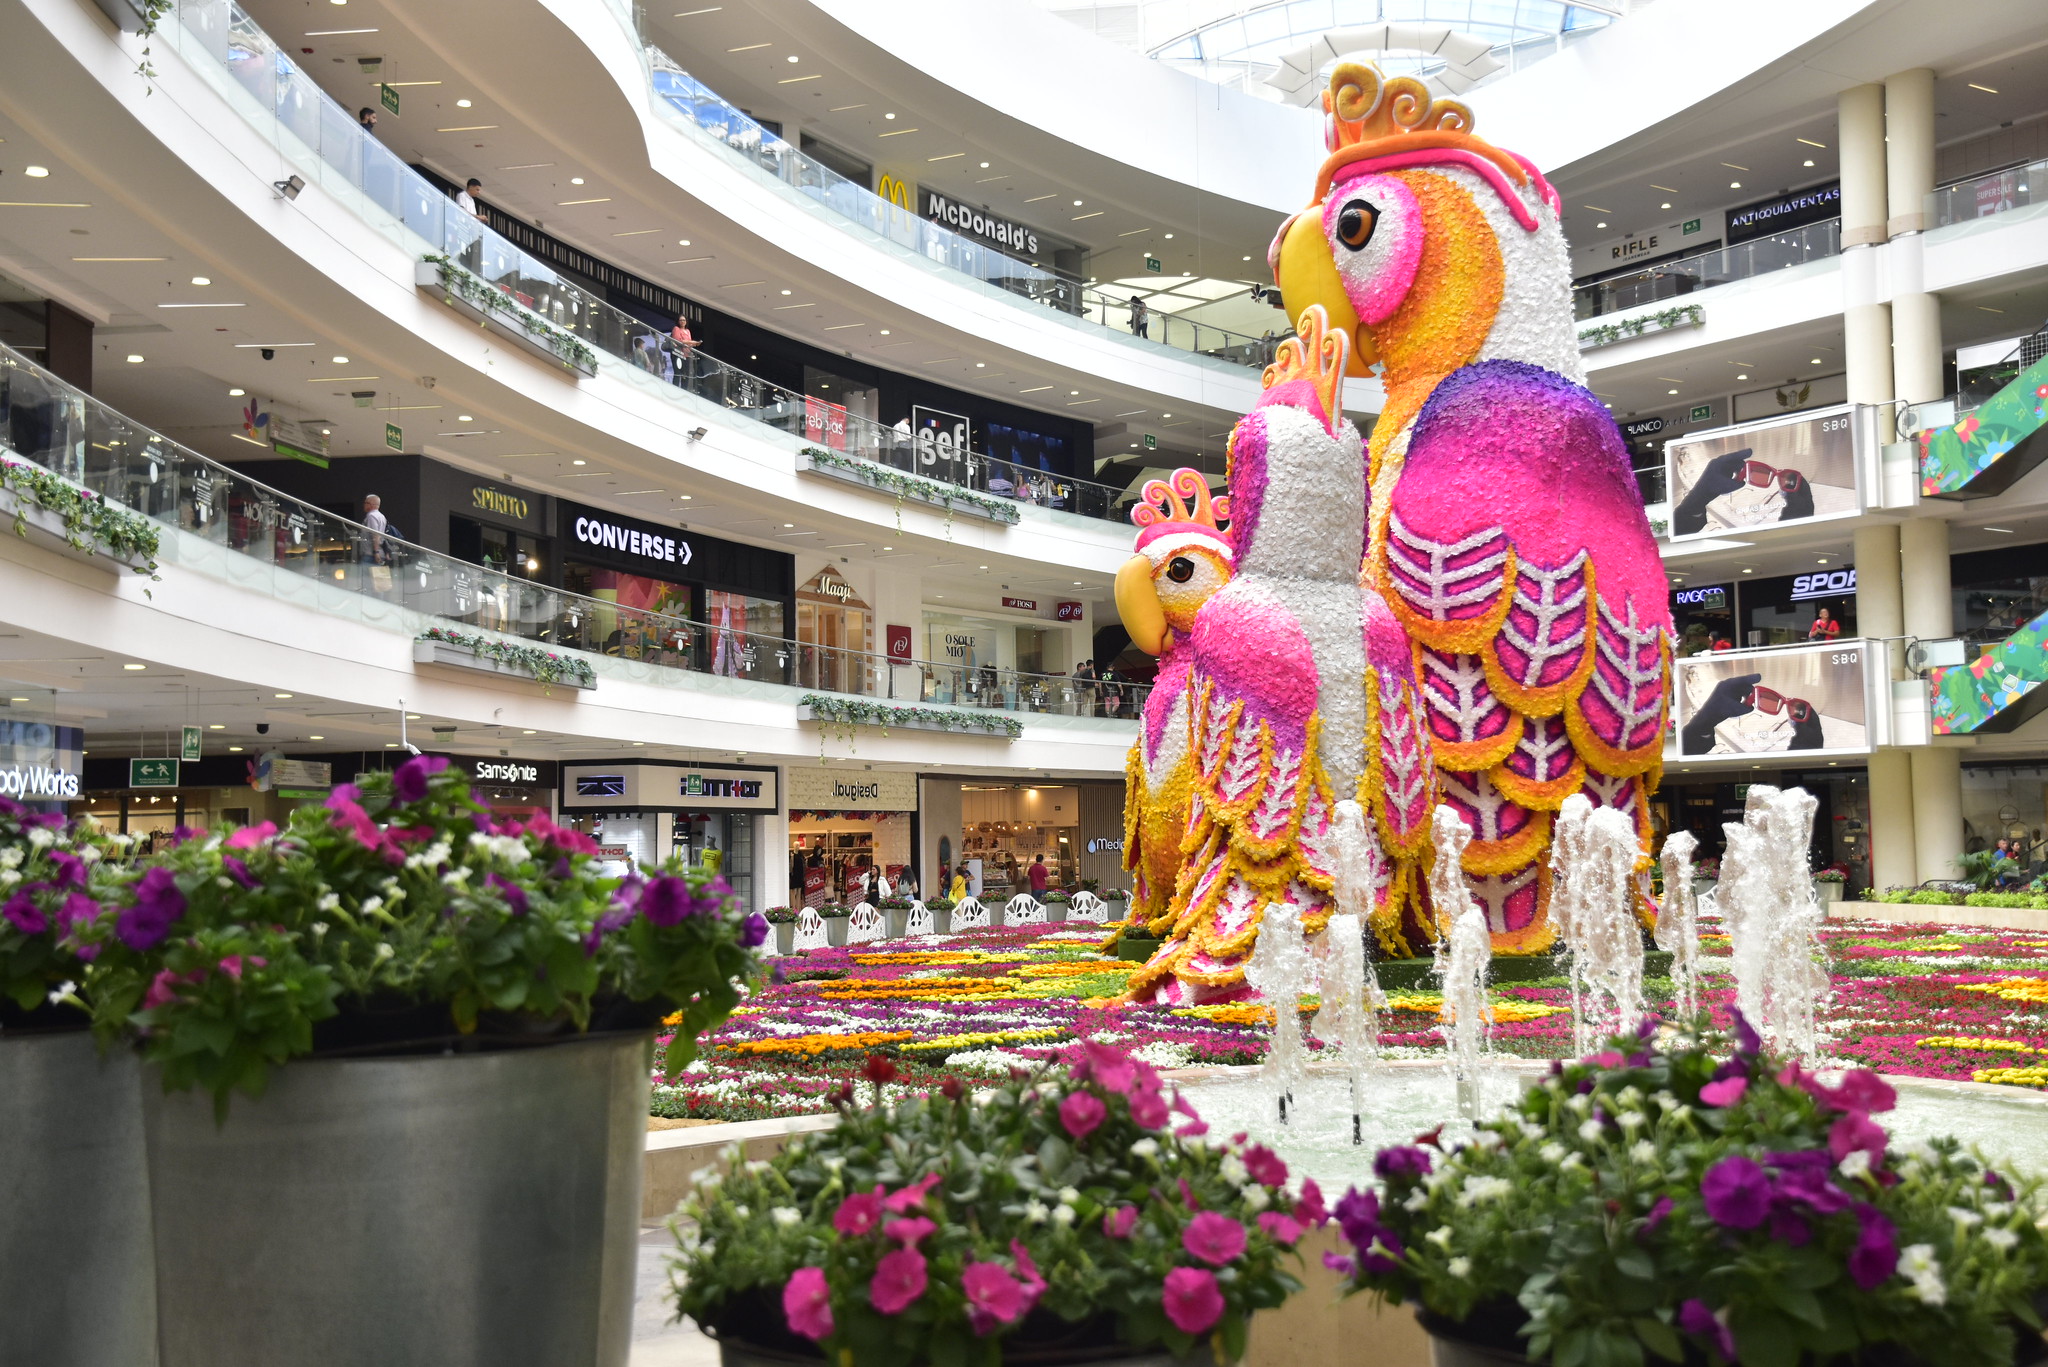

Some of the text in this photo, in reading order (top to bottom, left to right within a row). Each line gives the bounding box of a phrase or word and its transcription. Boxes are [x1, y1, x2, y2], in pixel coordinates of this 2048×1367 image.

[1976, 184, 2013, 200] SUPER SLE
[929, 193, 1038, 254] McDonald's
[1612, 235, 1658, 259] RIFLE
[918, 423, 965, 466] gef
[576, 516, 675, 563] CONVERSE
[816, 575, 851, 603] Maaji
[945, 645, 964, 658] MIO
[953, 634, 976, 648] SOLE
[29, 764, 79, 797] Works
[476, 761, 537, 783] Samsonite
